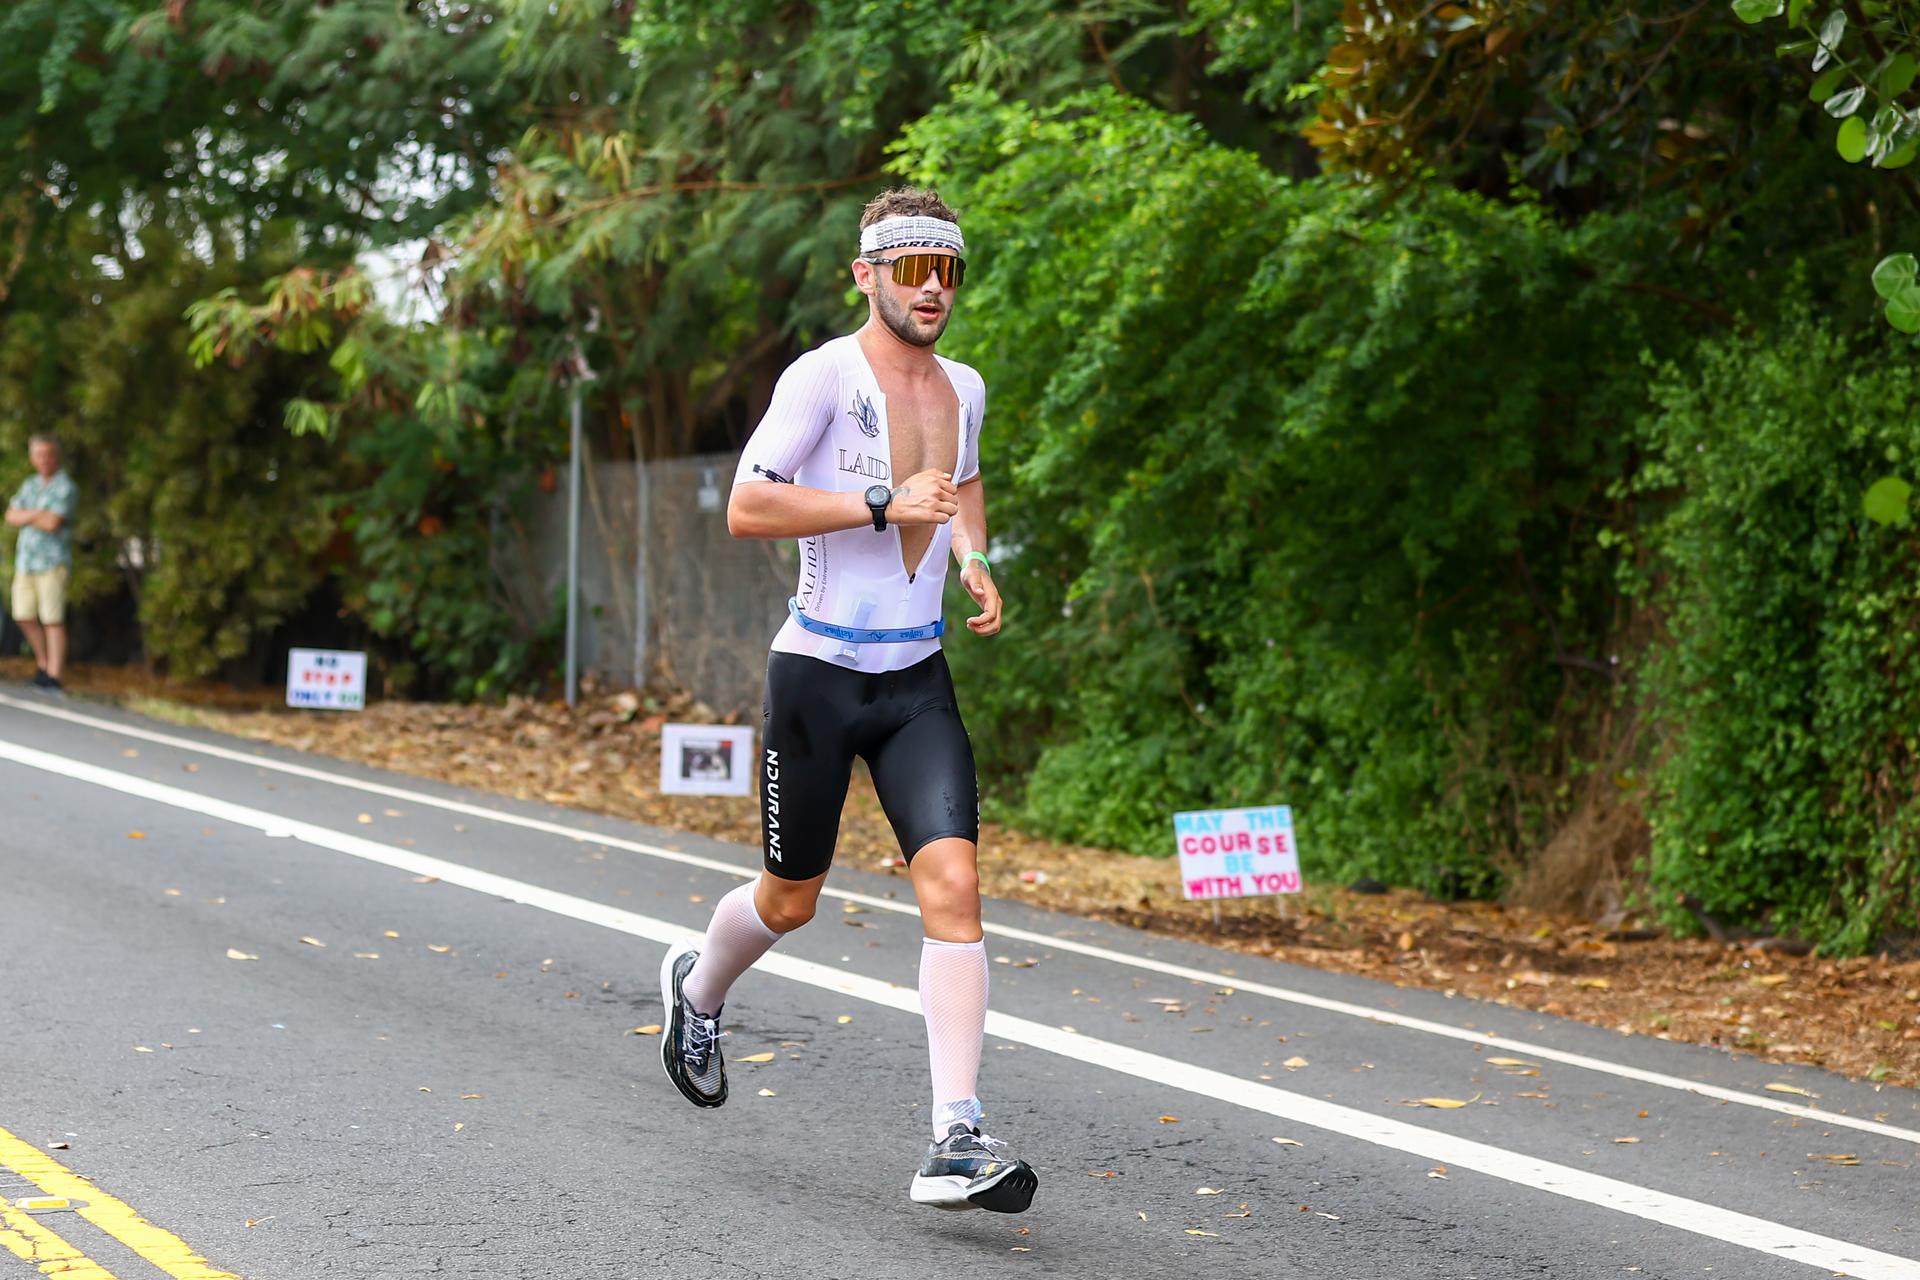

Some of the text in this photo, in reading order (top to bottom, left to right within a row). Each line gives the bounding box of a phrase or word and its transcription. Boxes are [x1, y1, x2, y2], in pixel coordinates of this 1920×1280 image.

[838, 448, 890, 480] LAID
[766, 748, 782, 863] NDURANZ
[1175, 809, 1290, 834] MAY THE
[1182, 832, 1288, 855] COURSE
[1223, 853, 1254, 874] BE
[1187, 872, 1298, 897] WITH YOU
